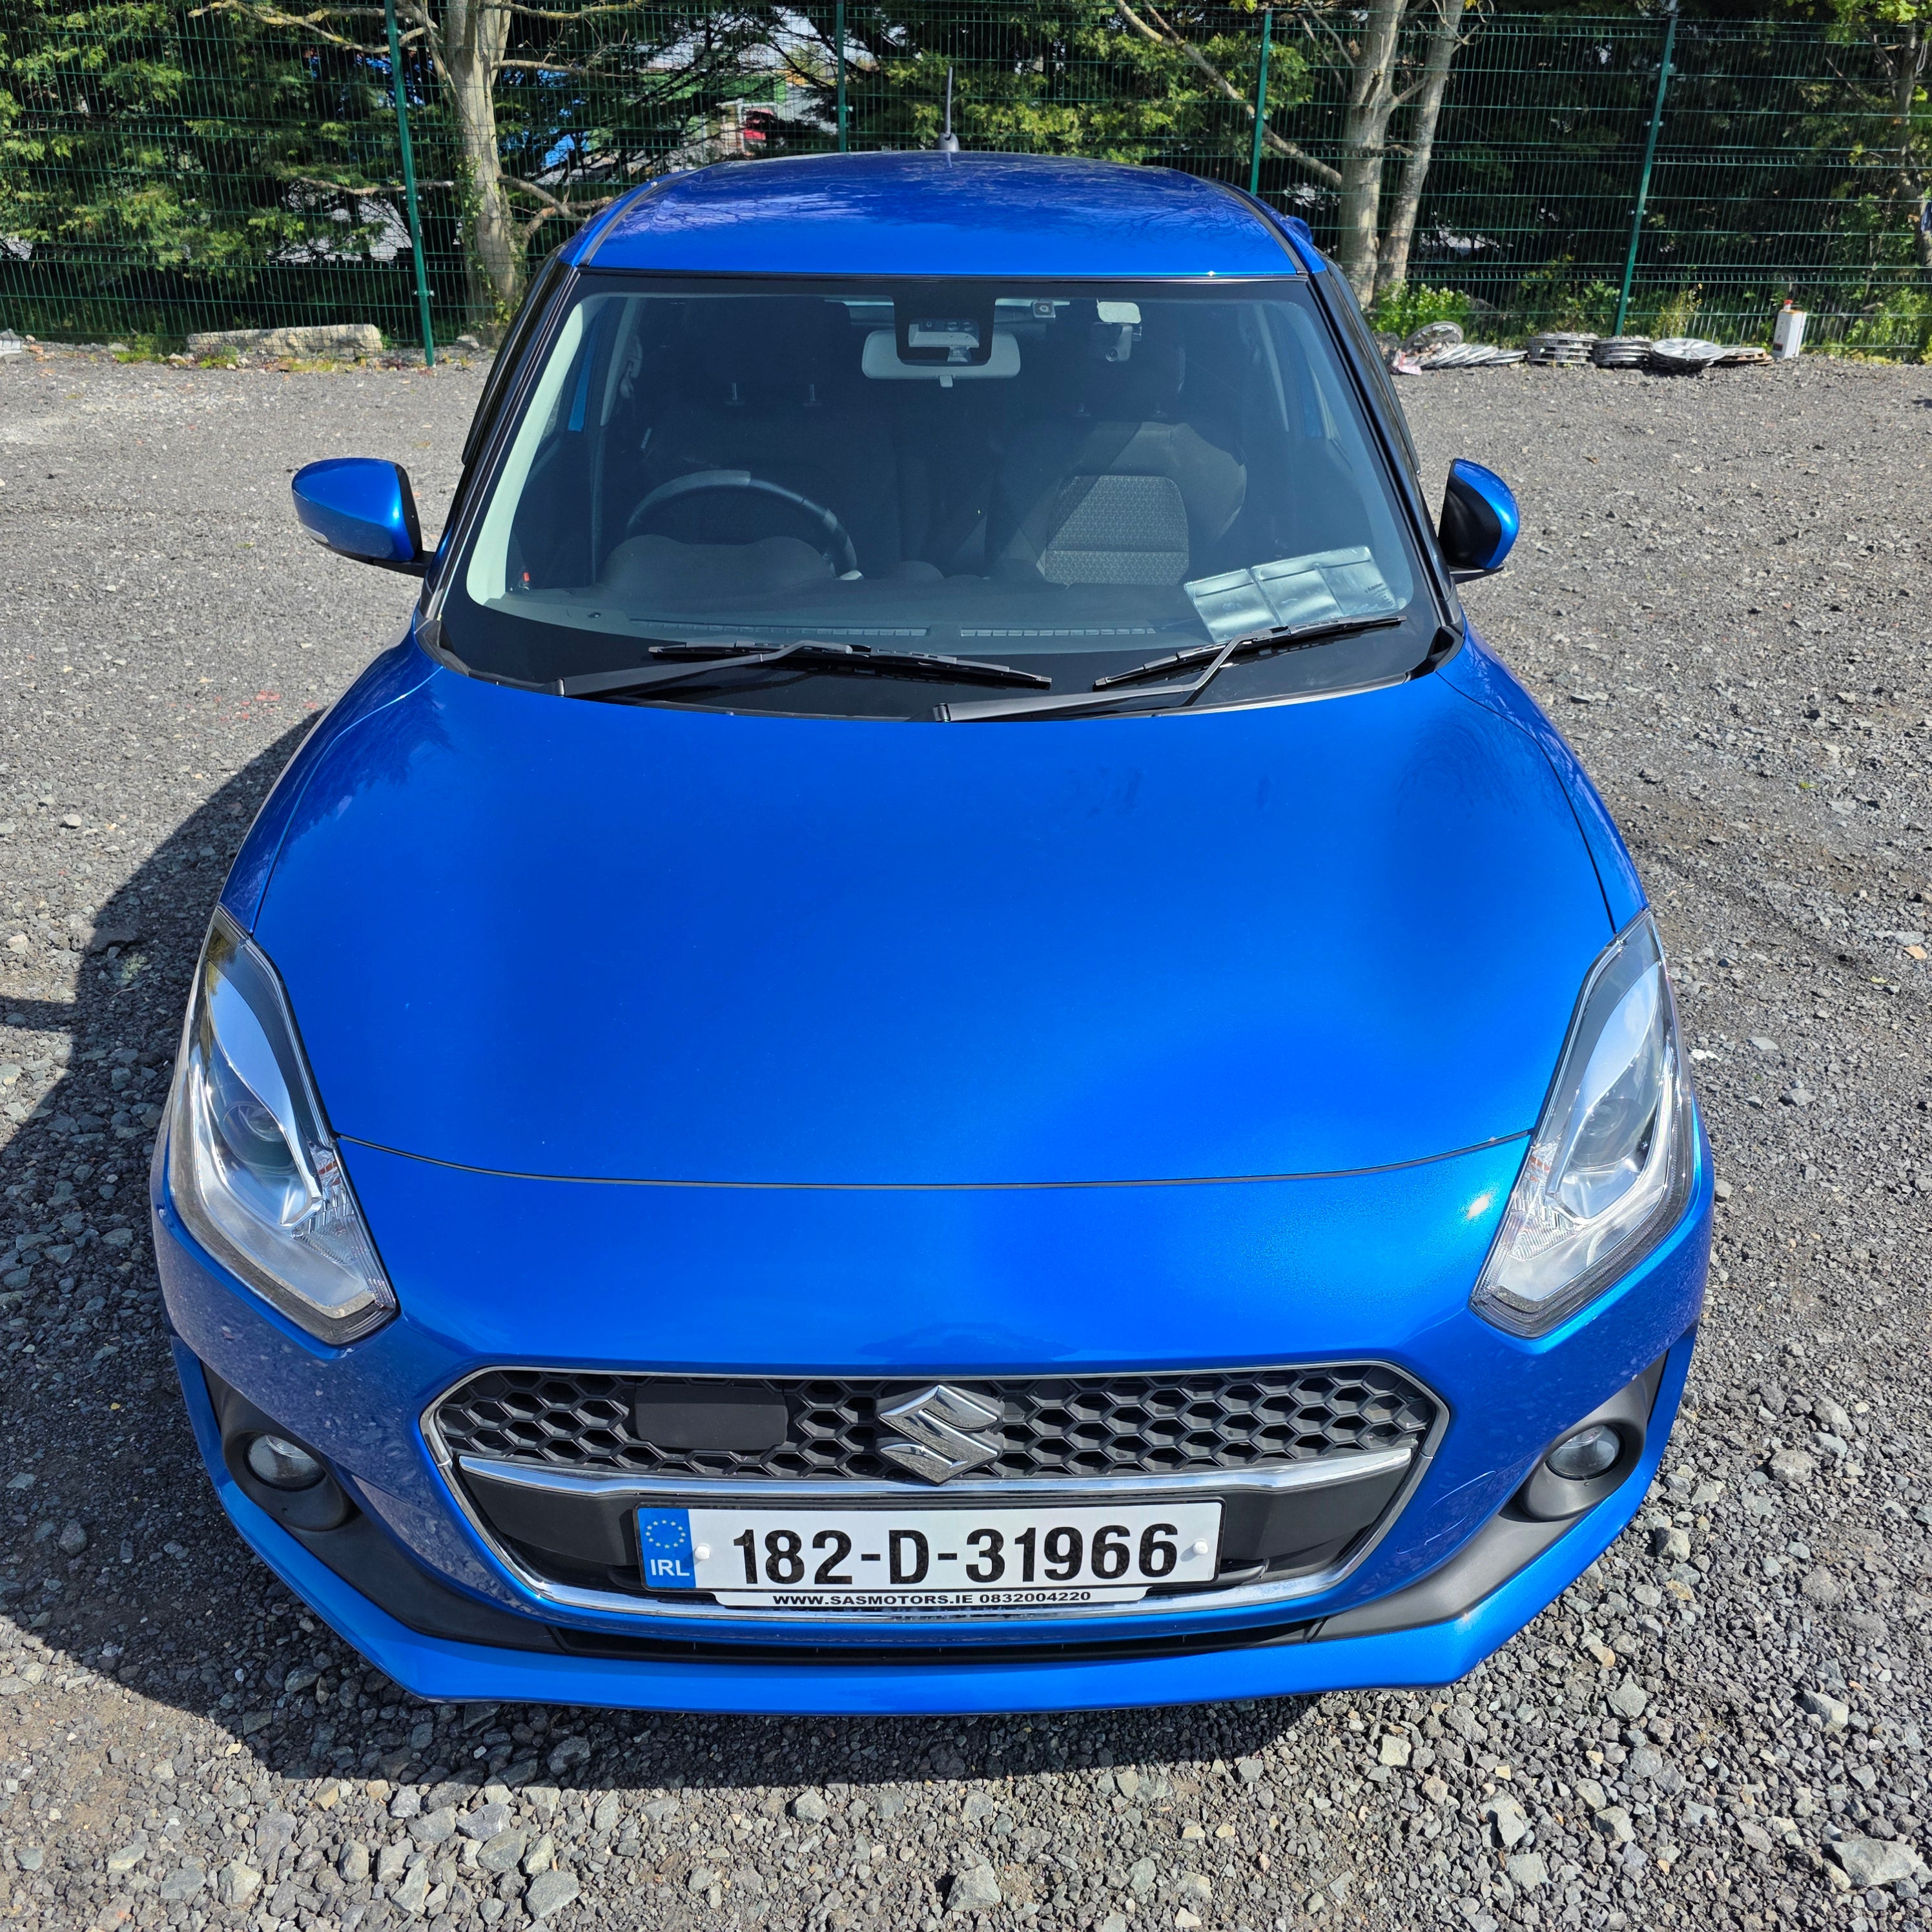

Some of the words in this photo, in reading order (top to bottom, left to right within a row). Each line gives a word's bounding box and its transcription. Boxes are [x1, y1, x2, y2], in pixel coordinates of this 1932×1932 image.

[733, 1523, 1178, 1585] 182-D-31966
[650, 1559, 690, 1576] IRL
[772, 1594, 973, 1605] WWW.SASMOTORS.IE
[979, 1591, 1091, 1603] 0832004220
